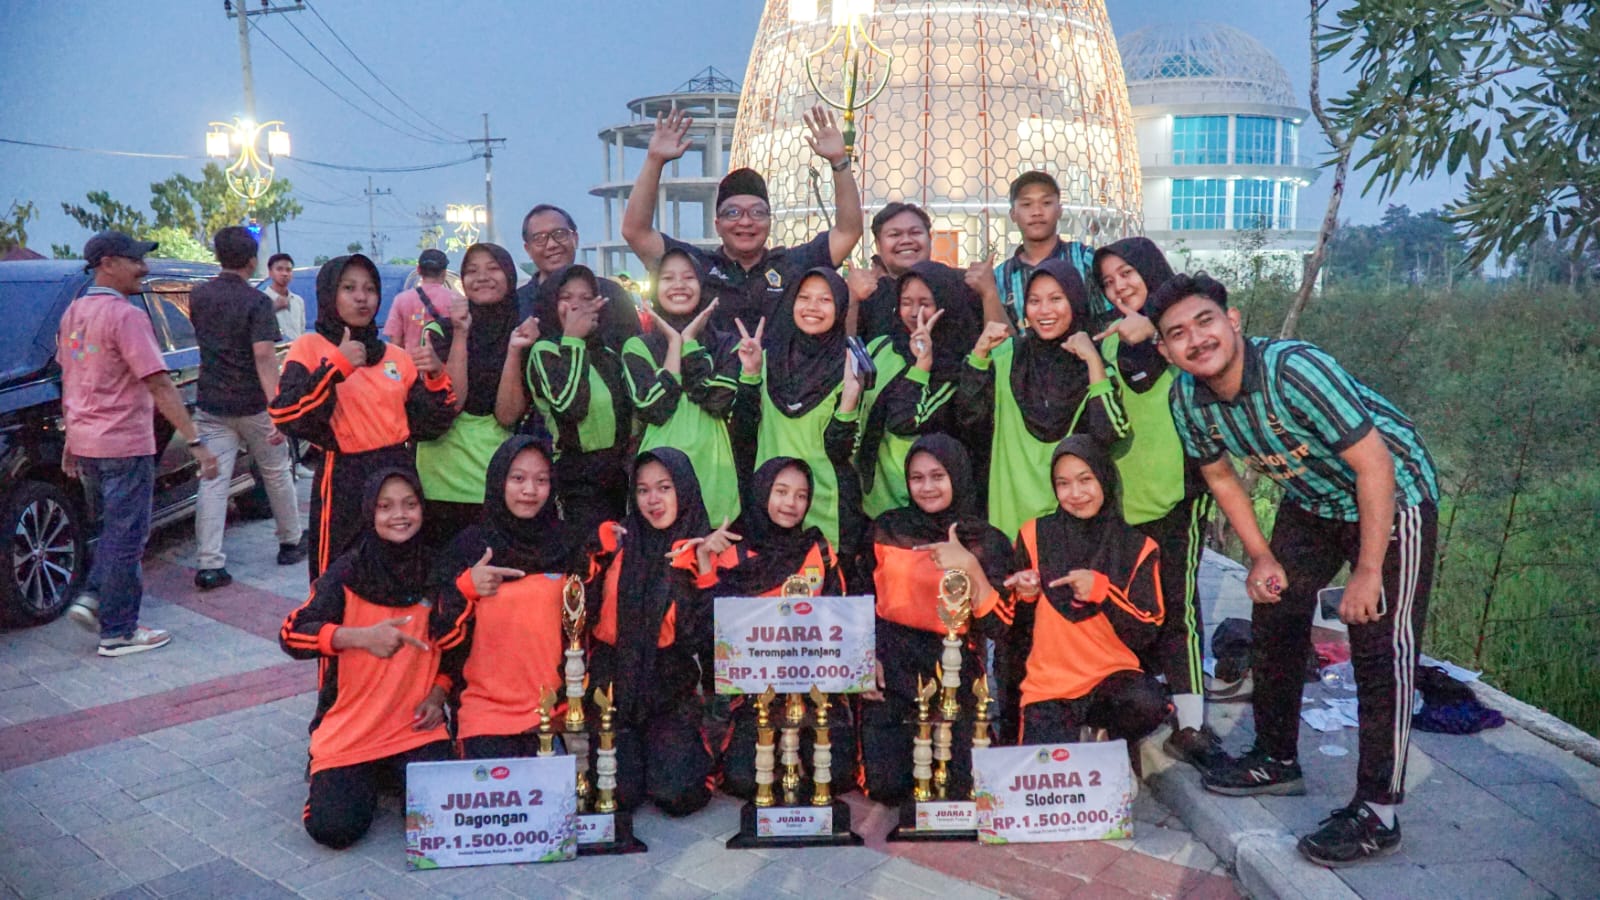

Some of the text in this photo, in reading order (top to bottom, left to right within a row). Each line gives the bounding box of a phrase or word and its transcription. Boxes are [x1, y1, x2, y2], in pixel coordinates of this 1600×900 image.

[746, 626, 843, 642] JUARA 2
[748, 647, 841, 659] Terompah Panjang
[728, 665, 862, 680] RP.1.500.000,-
[1009, 770, 1103, 791] JUARA 2
[1249, 767, 1271, 782] N
[441, 789, 543, 811] JUARA 2
[1025, 792, 1085, 807] Slodoran
[454, 813, 528, 829] Dagongan
[993, 809, 1121, 830] RP.1.500.000,-
[420, 830, 562, 851] RP.1.500.000,-
